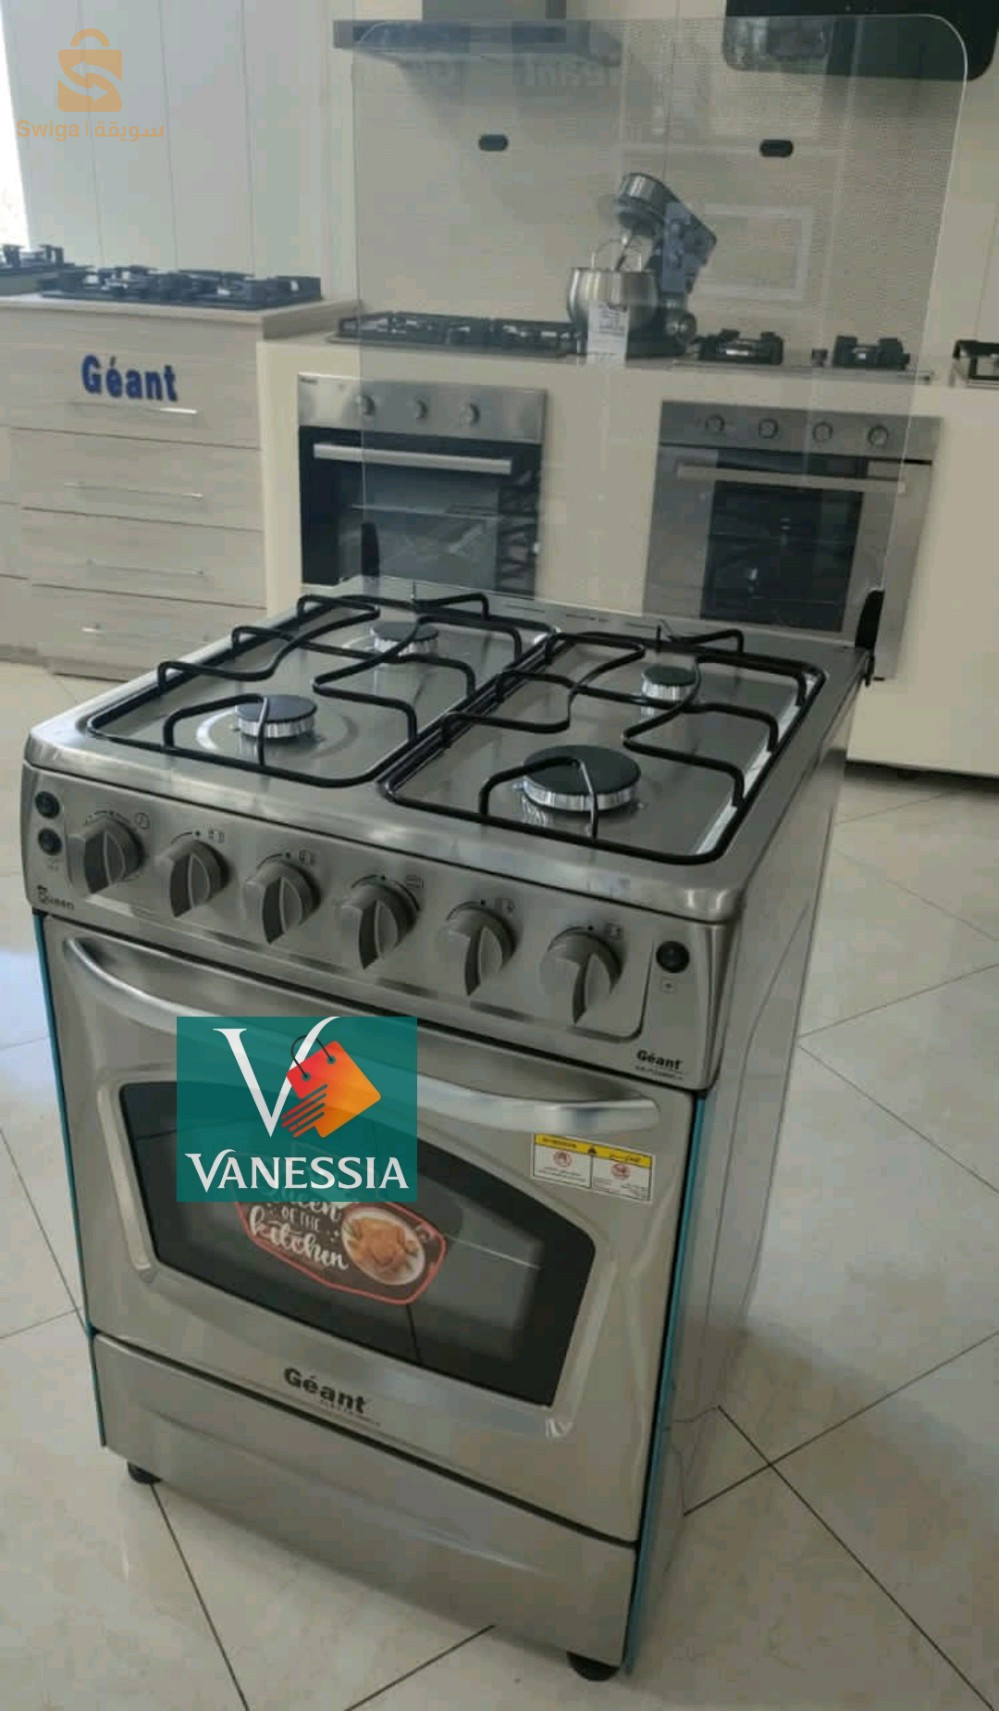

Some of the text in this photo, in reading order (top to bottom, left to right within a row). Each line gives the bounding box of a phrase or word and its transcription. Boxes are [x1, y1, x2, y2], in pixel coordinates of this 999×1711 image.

[82, 354, 178, 402] Géant
[636, 1049, 683, 1070] Géant
[284, 1367, 366, 1415] Géant
